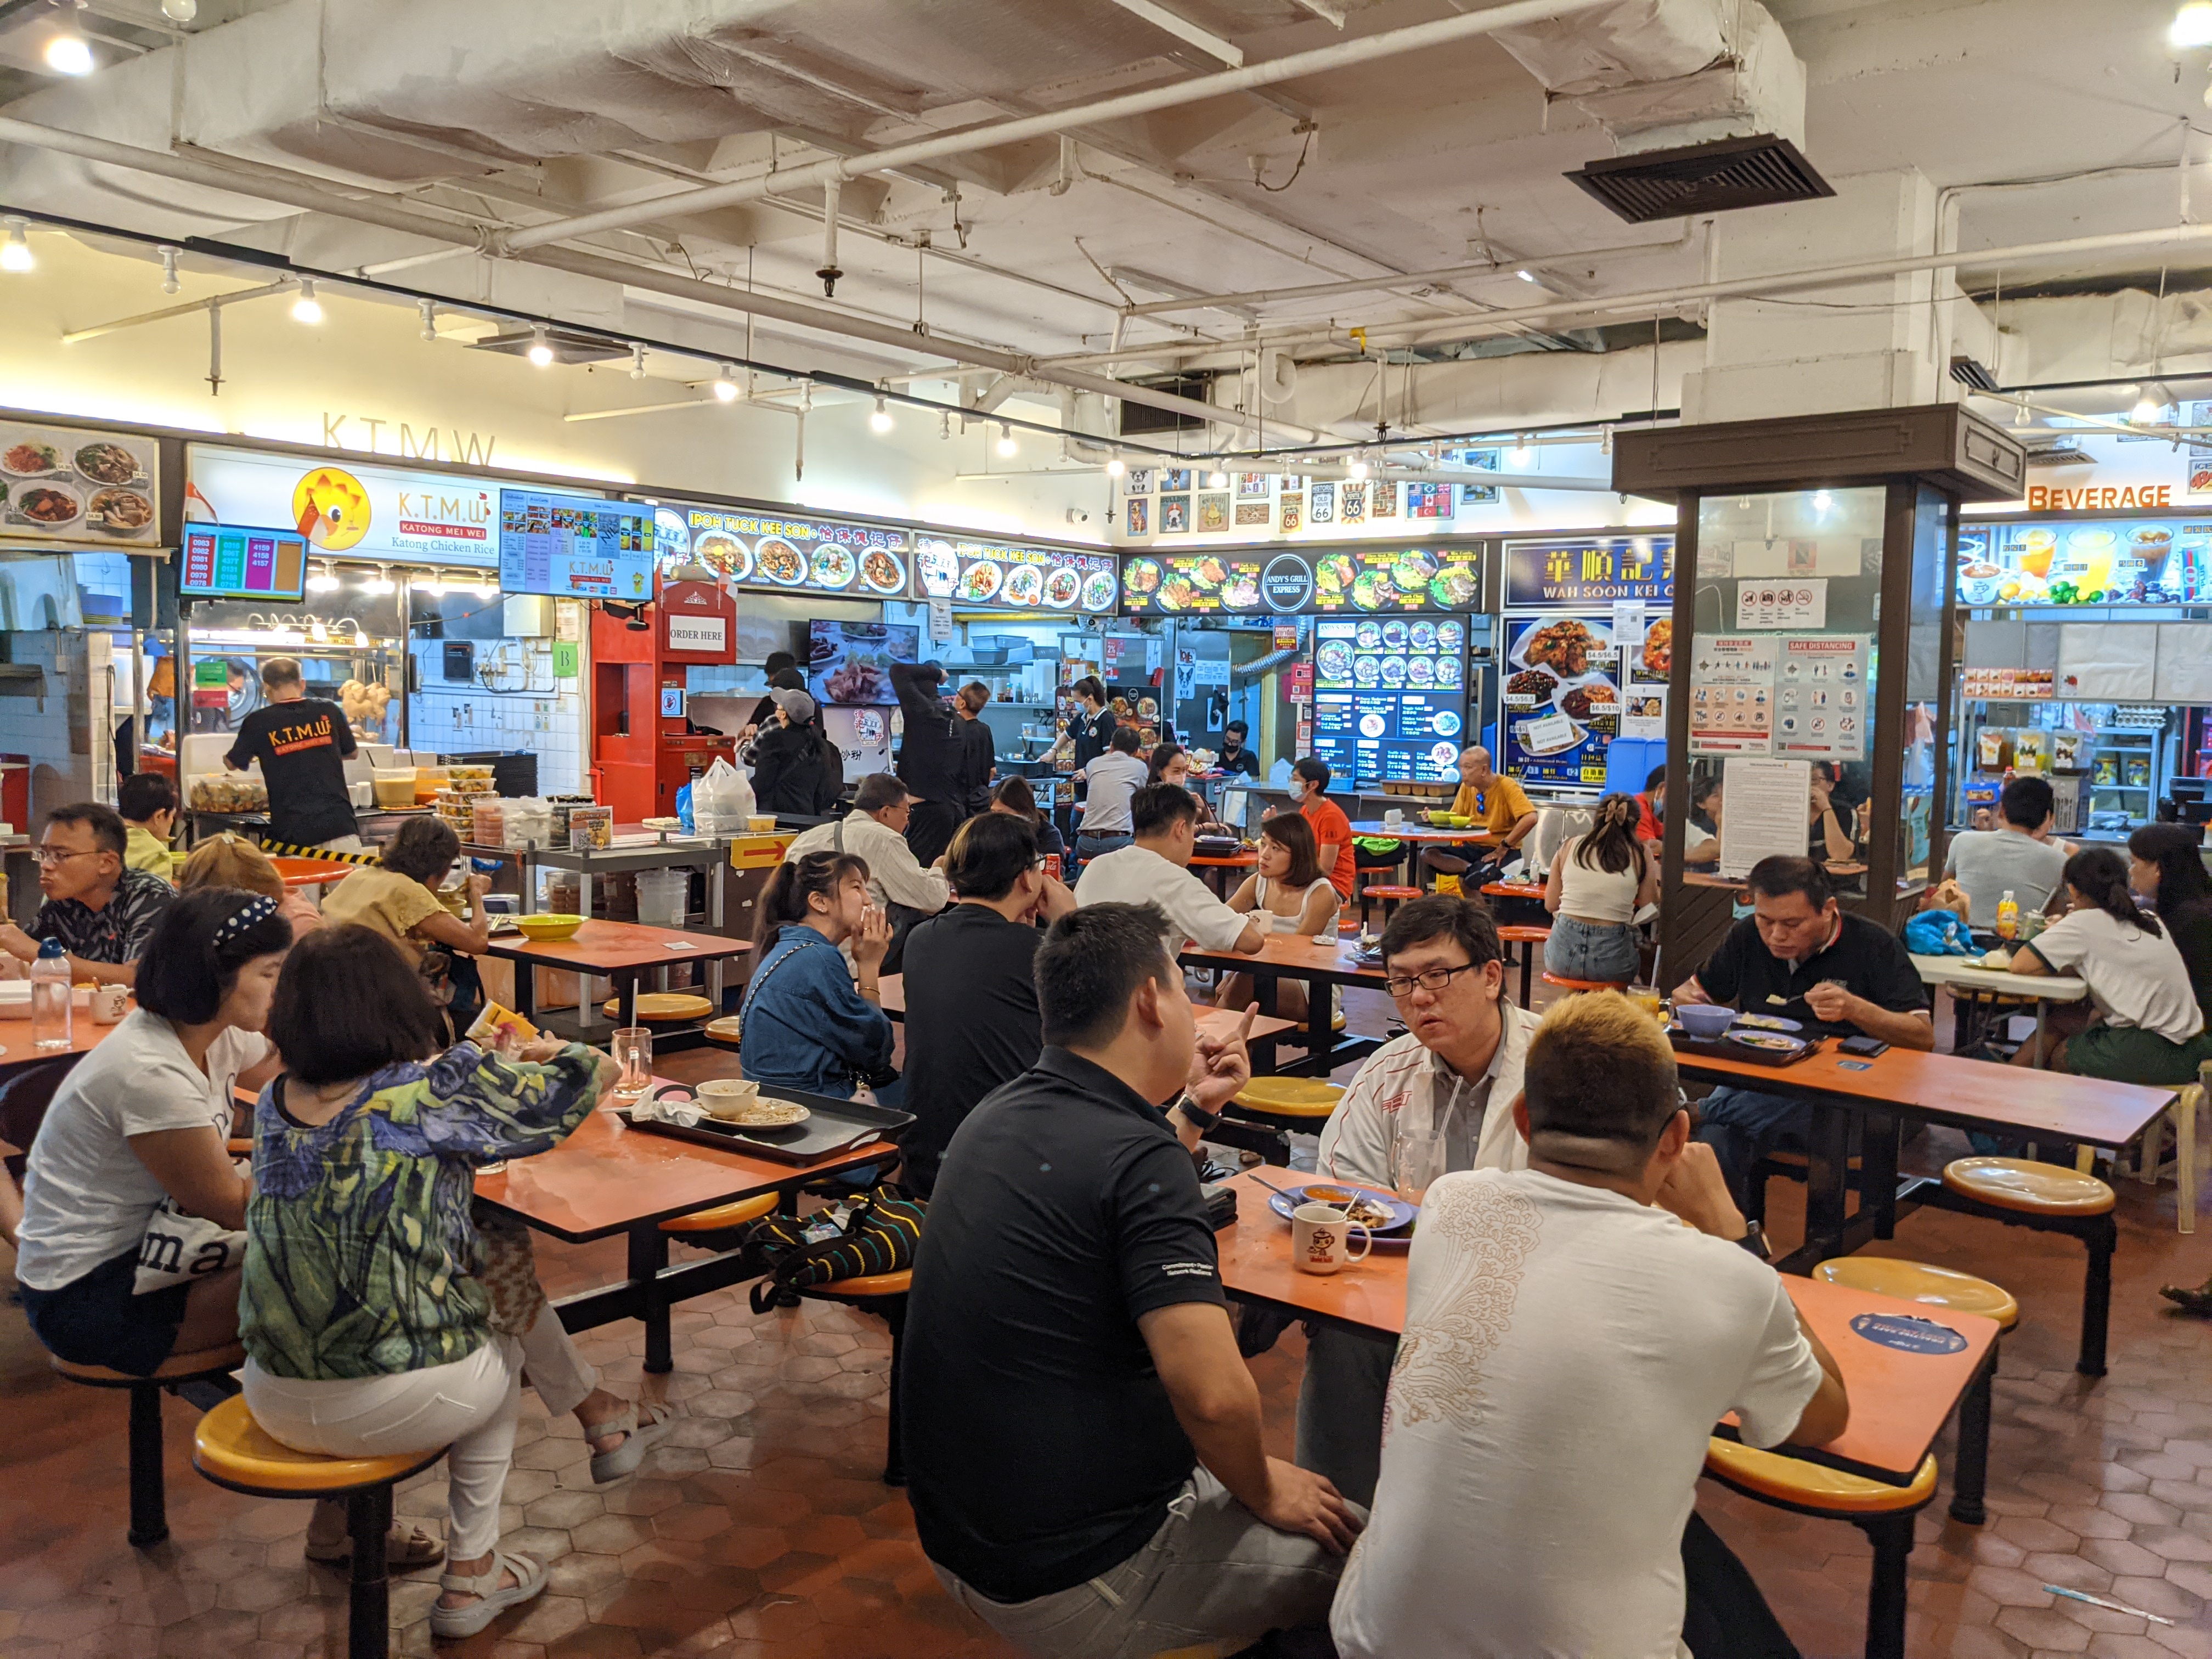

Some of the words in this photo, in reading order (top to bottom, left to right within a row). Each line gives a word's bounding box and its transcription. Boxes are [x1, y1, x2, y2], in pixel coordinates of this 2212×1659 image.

[2029, 485, 2171, 510] BEVERAGE
[1316, 508, 1329, 518] 66
[1346, 500, 1360, 515] 66
[690, 512, 722, 529] IPOH
[725, 517, 758, 533] TUCK
[761, 521, 781, 535] KEE
[785, 523, 810, 539] SON
[1285, 515, 1297, 527] 66
[402, 523, 442, 534] KATONG
[445, 528, 463, 536] MEI
[467, 529, 485, 538] WEI
[392, 537, 428, 552] Katong
[431, 540, 471, 553] Chicken
[474, 544, 494, 554] Rice
[958, 544, 981, 557] IPOH
[984, 546, 1008, 561] TUCK
[1011, 550, 1024, 562] KEE
[1027, 552, 1043, 565] SON
[1543, 585, 1577, 599] WAH
[1583, 585, 1628, 598] SOON
[1634, 584, 1658, 597] KEI
[670, 629, 699, 640] ORDER
[701, 630, 723, 641] HERE
[561, 651, 569, 667] B
[1542, 719, 1563, 728] AVAILABLE
[1546, 732, 1567, 742] AVAILABLE
